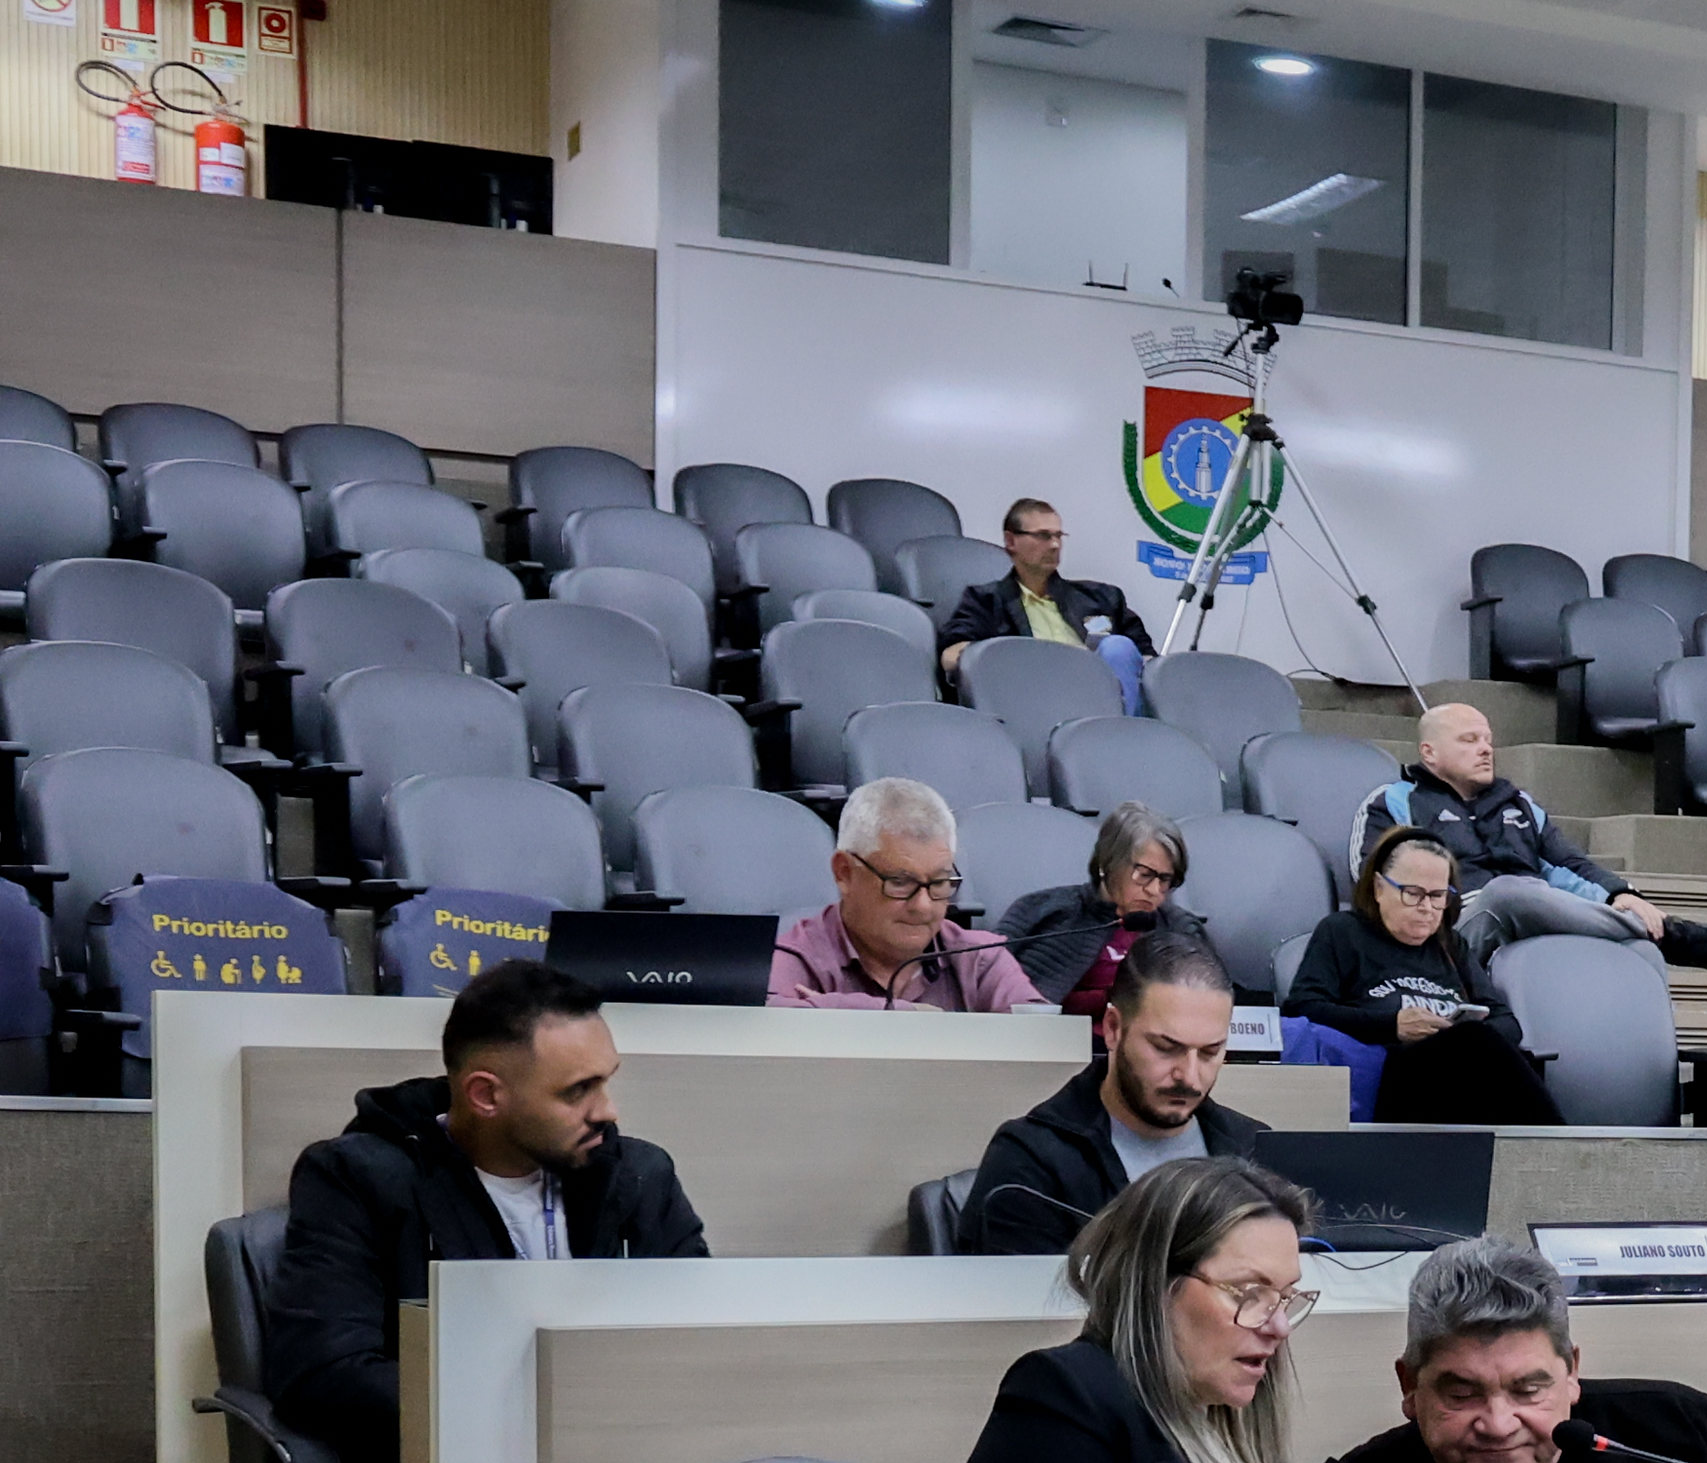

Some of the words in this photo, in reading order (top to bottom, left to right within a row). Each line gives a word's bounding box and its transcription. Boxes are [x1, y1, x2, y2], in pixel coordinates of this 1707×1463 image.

[152, 914, 289, 939] Prioritário
[1230, 1022, 1265, 1036] BOENO
[1619, 1245, 1666, 1258] JULIANO
[1667, 1244, 1706, 1257] SOUTO
